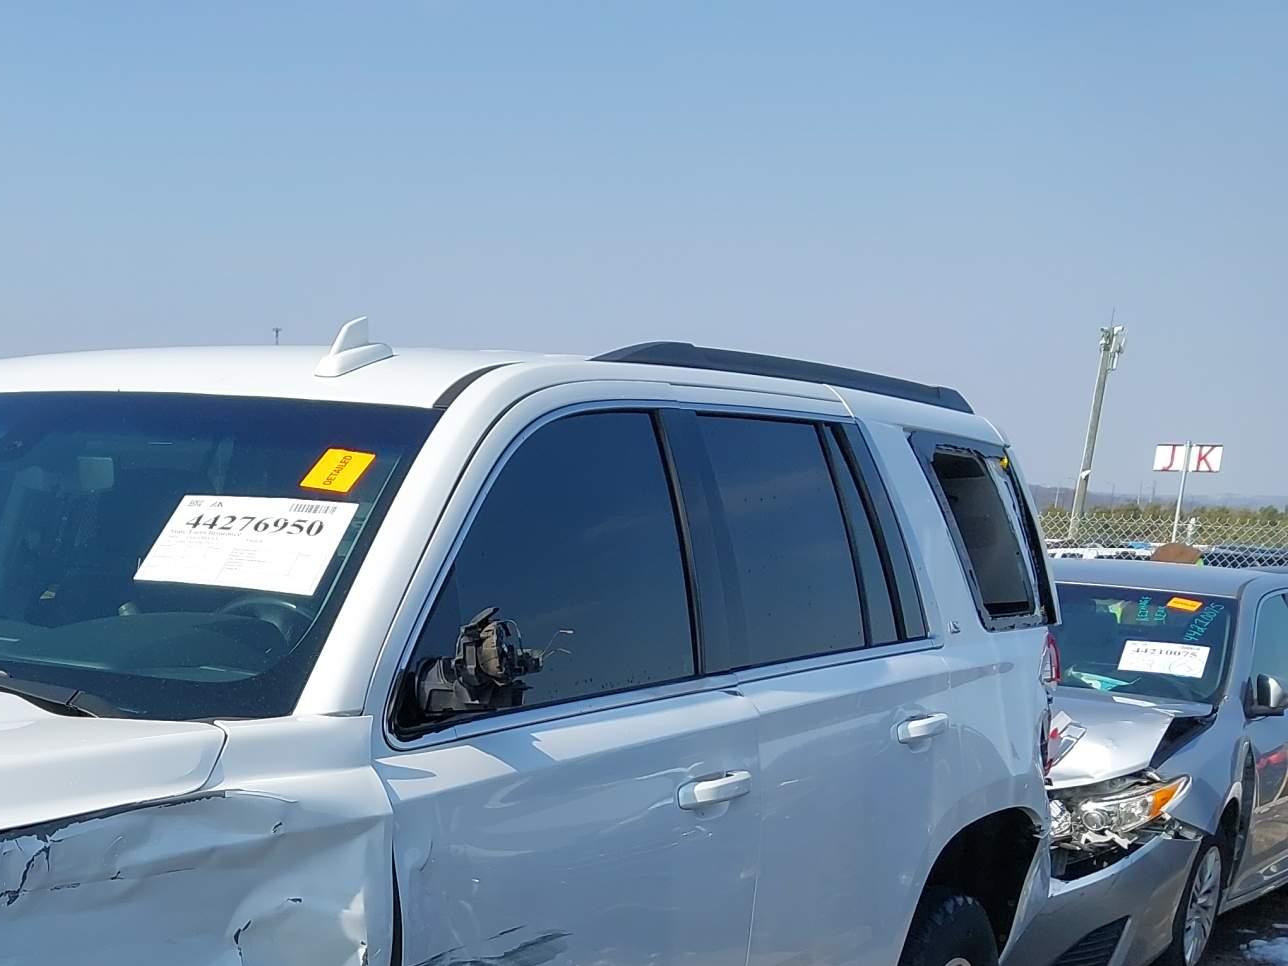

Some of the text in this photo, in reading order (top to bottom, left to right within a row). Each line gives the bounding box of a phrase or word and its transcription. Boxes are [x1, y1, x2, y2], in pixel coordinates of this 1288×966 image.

[323, 455, 353, 486] DETAILED
[1160, 445, 1217, 472] J K
[185, 513, 325, 537] 44276950
[1131, 647, 1199, 658] 44210075
